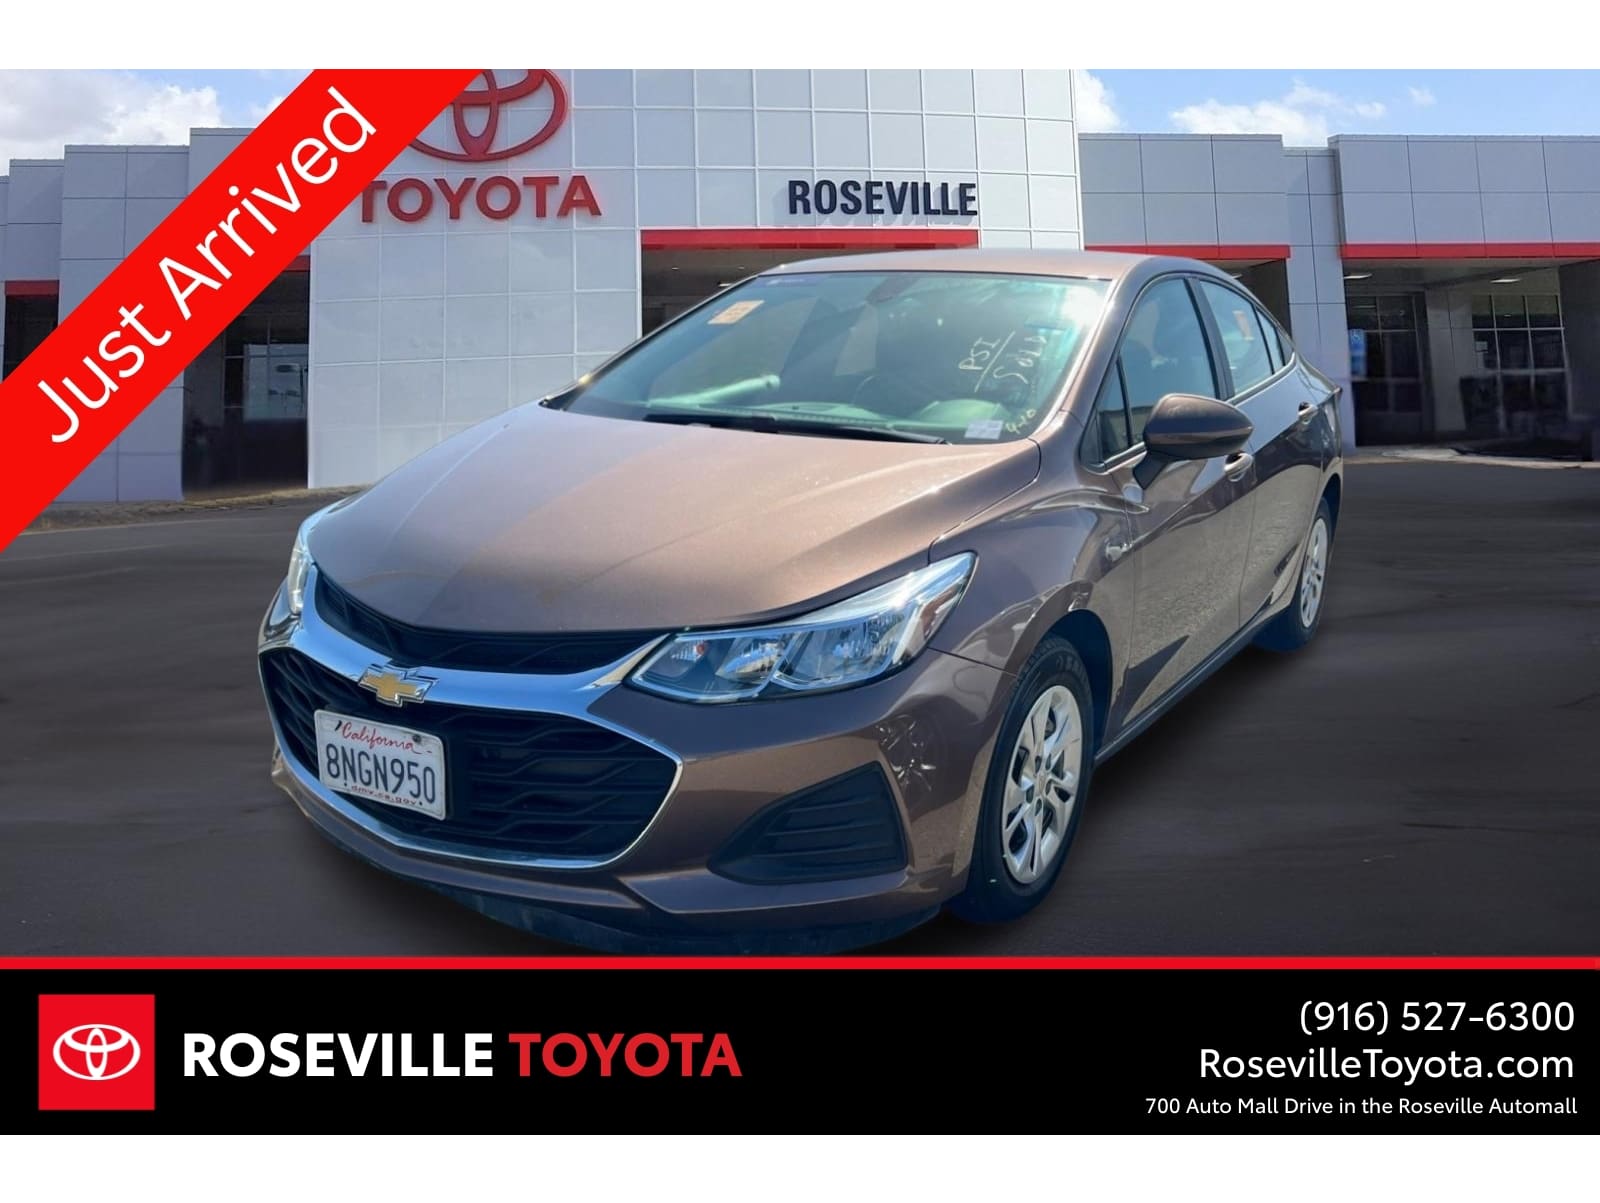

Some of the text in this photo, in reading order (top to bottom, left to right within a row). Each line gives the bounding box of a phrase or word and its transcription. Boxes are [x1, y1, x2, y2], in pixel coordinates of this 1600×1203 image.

[360, 175, 602, 223] TOYOTA
[788, 179, 978, 216] ROSEVILLE
[341, 721, 424, 754] California
[326, 743, 436, 804] 8NGN950
